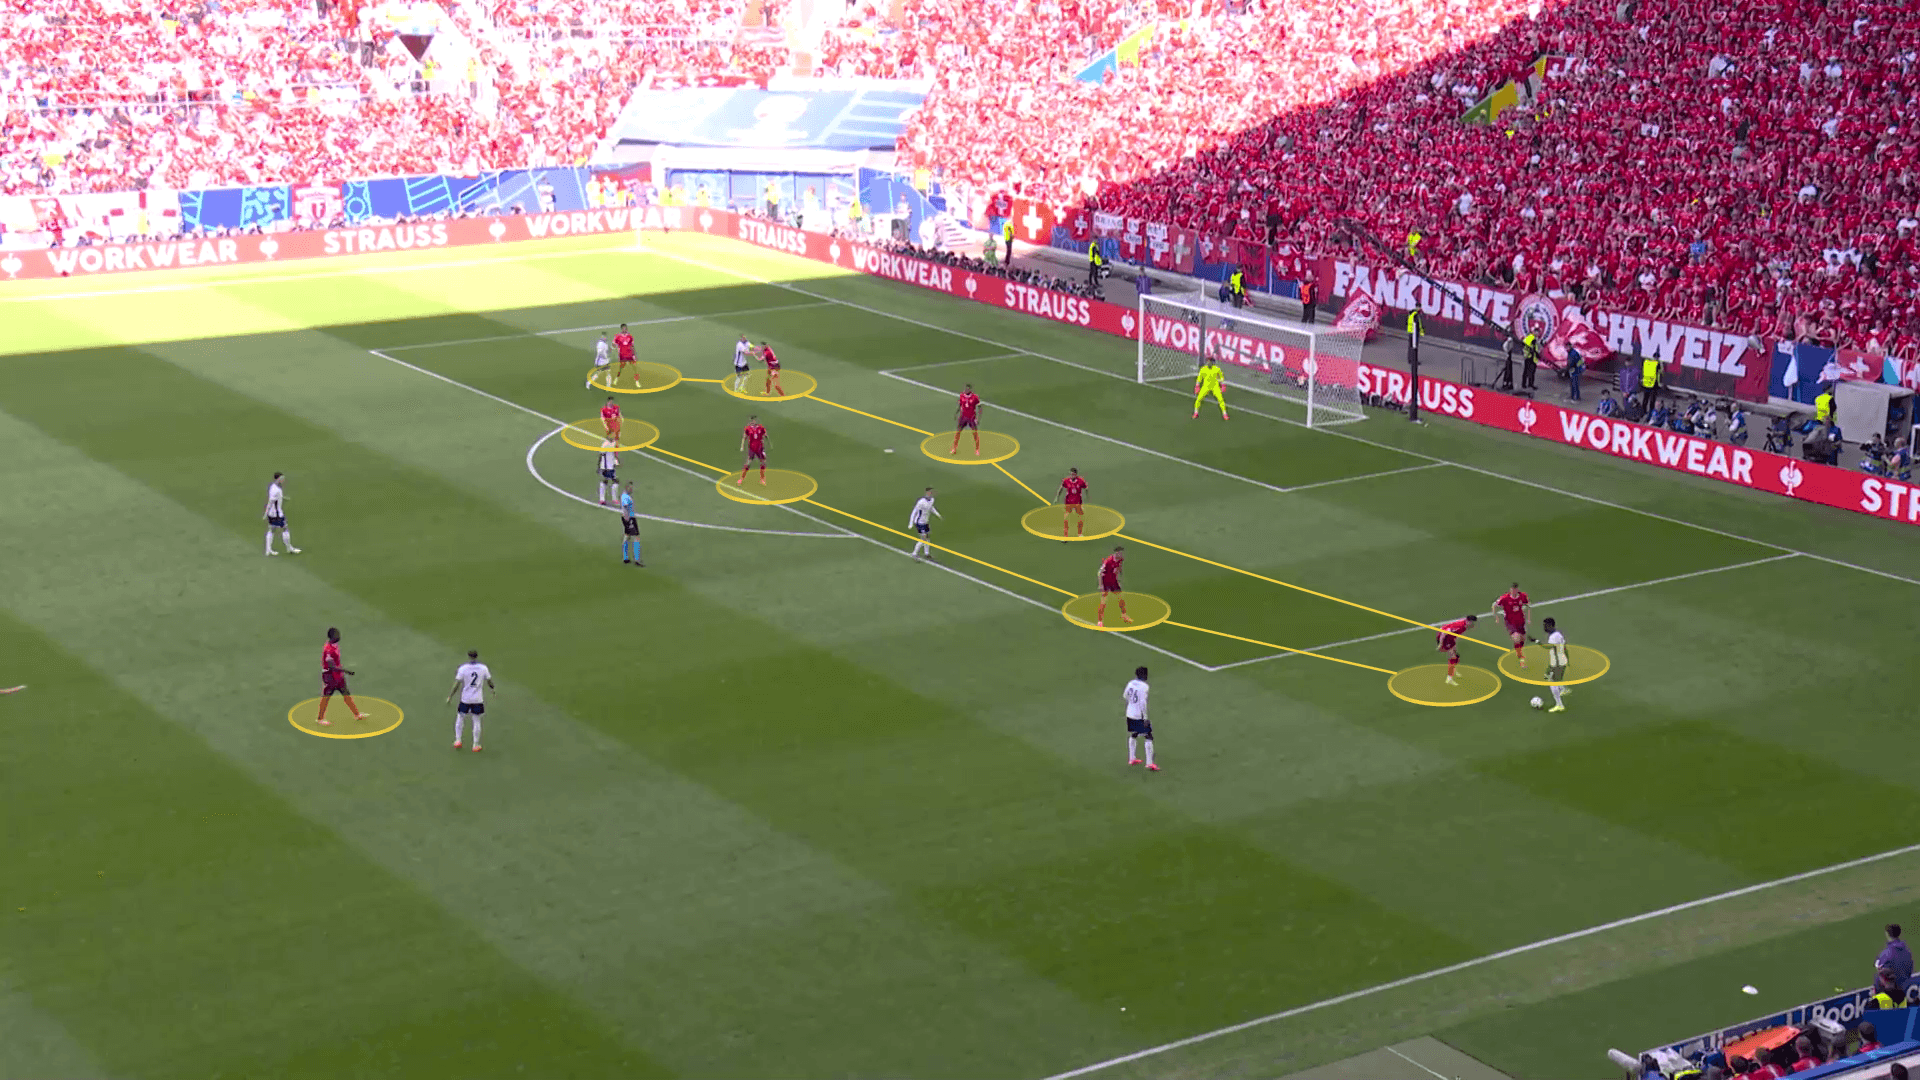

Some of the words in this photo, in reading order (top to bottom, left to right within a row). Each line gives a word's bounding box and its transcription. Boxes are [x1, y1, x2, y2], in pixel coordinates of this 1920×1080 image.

[47, 239, 238, 274] WORKWEAR
[324, 225, 448, 253] STRAUSS
[525, 207, 681, 238] WORKWEAR
[1333, 261, 1515, 329] FANKURVE
[739, 218, 807, 255] STRAUSS
[852, 246, 953, 292] WORKWEAR
[1005, 284, 1091, 326] STRAUSS
[1150, 316, 1285, 370] WORKWEAR
[1560, 410, 1754, 485] WORKWEAR
[470, 671, 478, 687] 2
